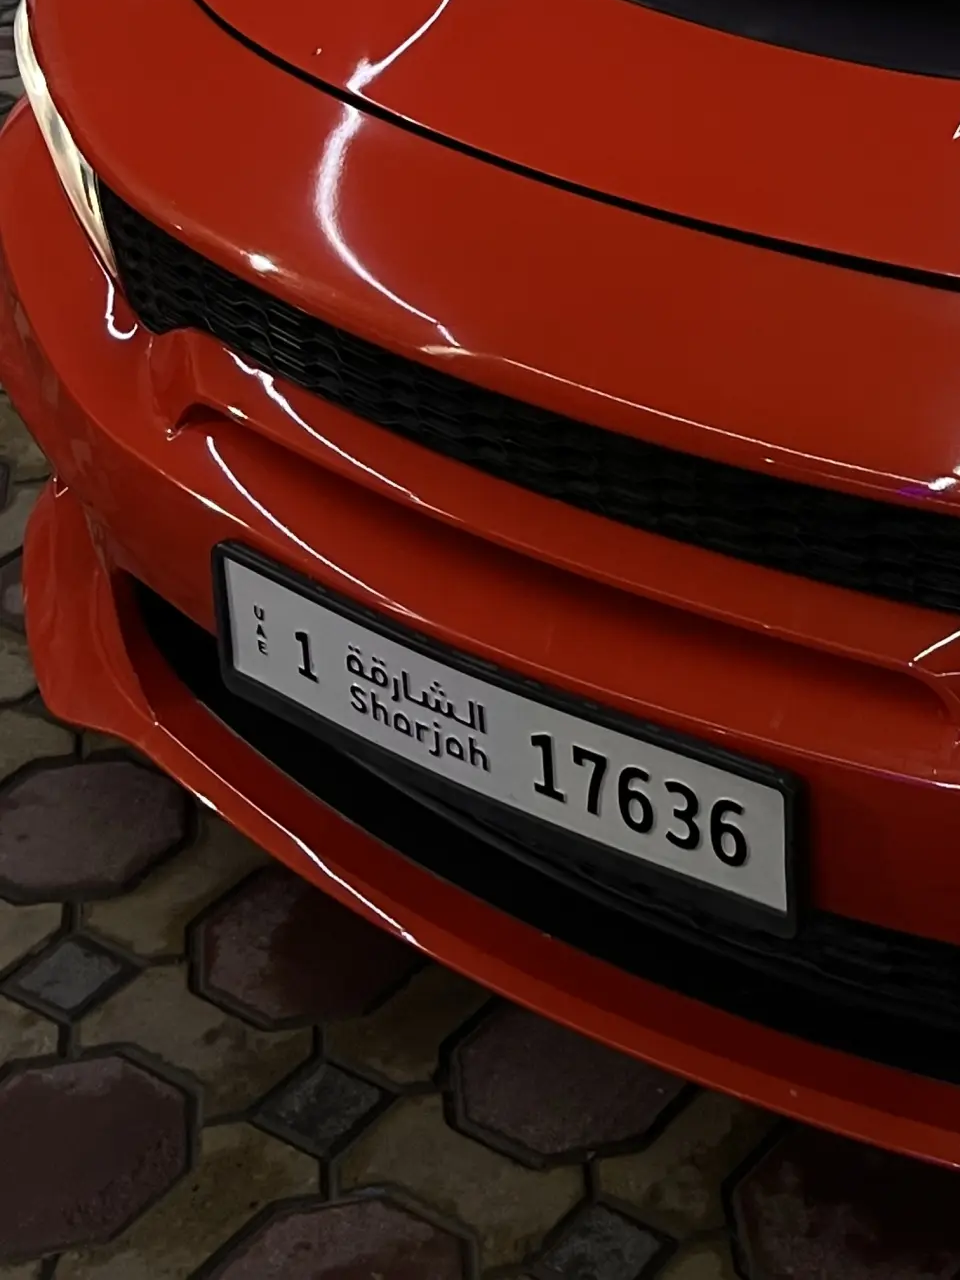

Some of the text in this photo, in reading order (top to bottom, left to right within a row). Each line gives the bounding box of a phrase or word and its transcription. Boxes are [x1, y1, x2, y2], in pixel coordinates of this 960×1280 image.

[253, 605, 269, 655] UAE
[294, 631, 319, 683] 1
[345, 645, 488, 734] الشارقة
[349, 685, 491, 772] Sharjah
[530, 733, 748, 867] 17636
